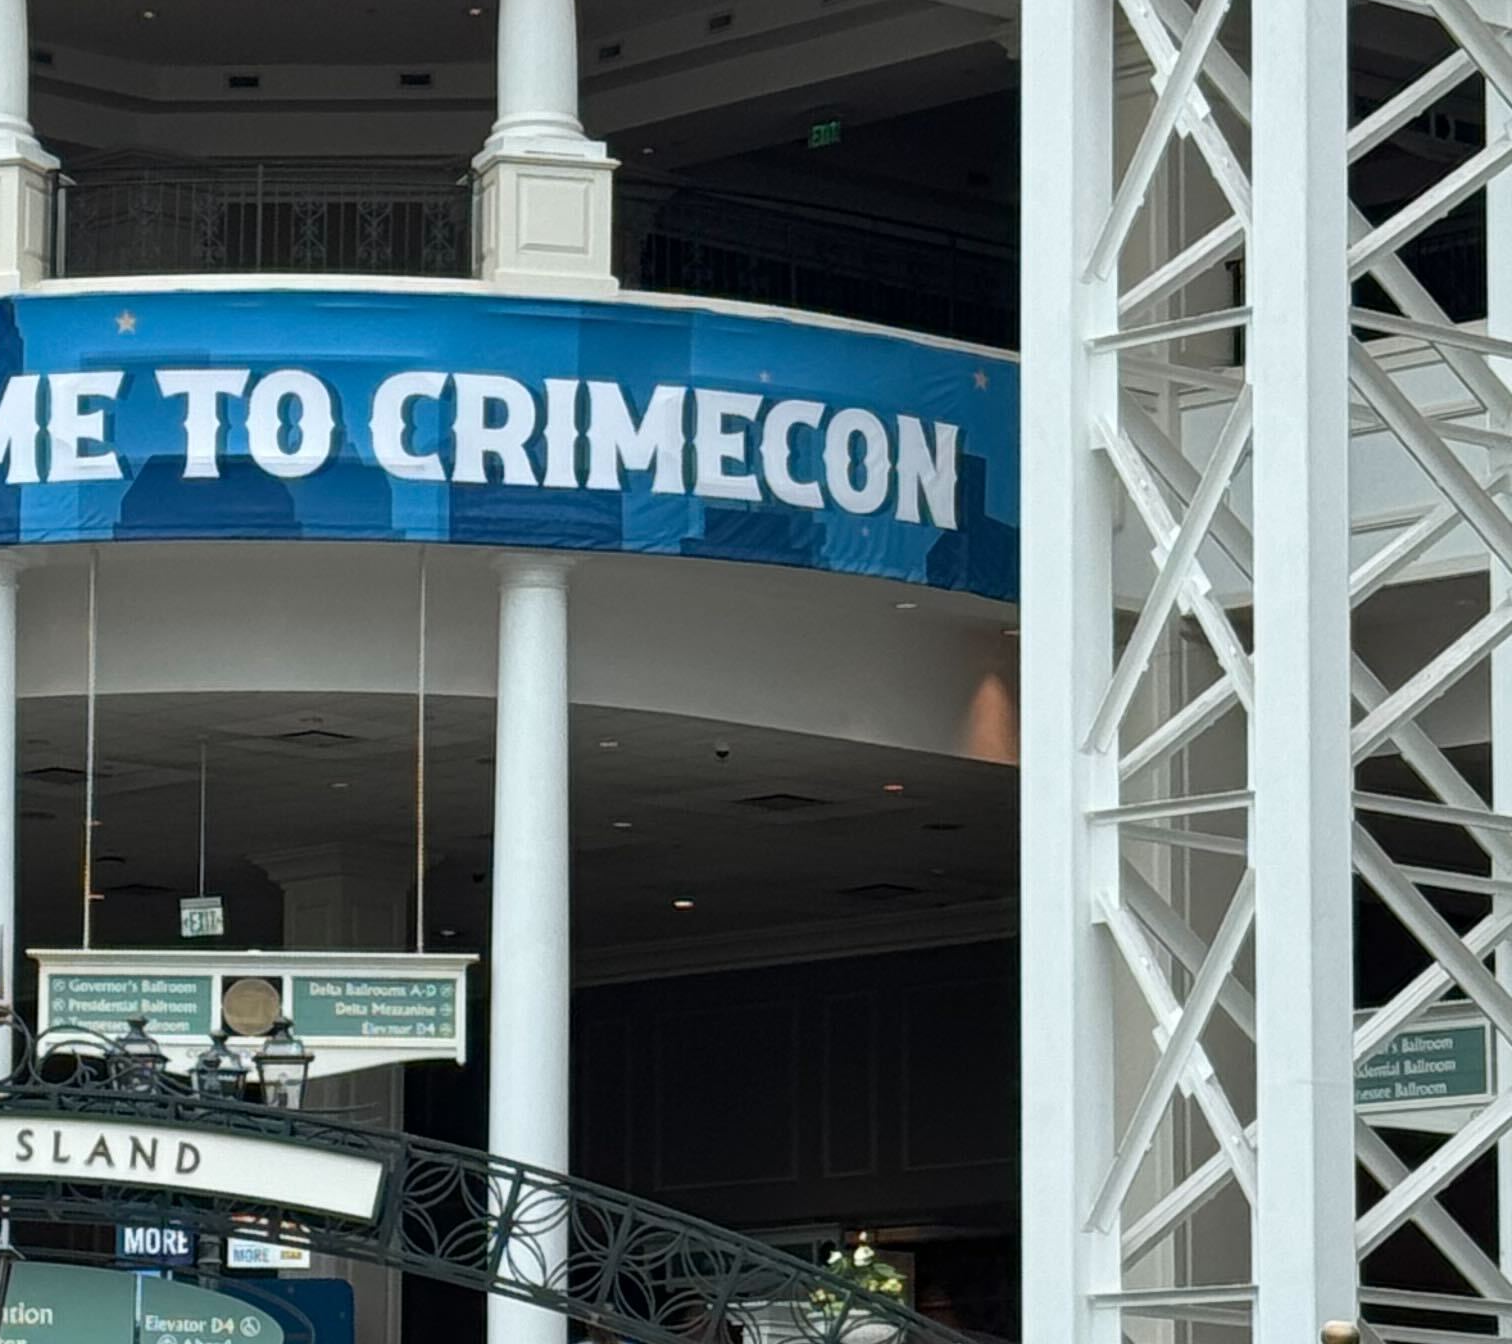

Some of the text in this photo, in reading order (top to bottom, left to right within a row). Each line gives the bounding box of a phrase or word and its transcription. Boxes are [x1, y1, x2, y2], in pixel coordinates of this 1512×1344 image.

[156, 367, 339, 481] TO
[368, 369, 964, 530] CRIMECON
[68, 978, 197, 993] Governor's Ballroom
[310, 982, 436, 997] Delta Ballrooms A-D
[68, 999, 197, 1013] Presidential Ballroom
[336, 1003, 436, 1017] Delta Mezzanine
[416, 1023, 436, 1036] D4
[1401, 1036, 1454, 1054] Ballroom
[1403, 1059, 1456, 1076] Ballroom
[1394, 1082, 1447, 1098] Ballroom
[124, 1227, 190, 1256] MORE
[145, 1315, 235, 1335] Elevator D4
